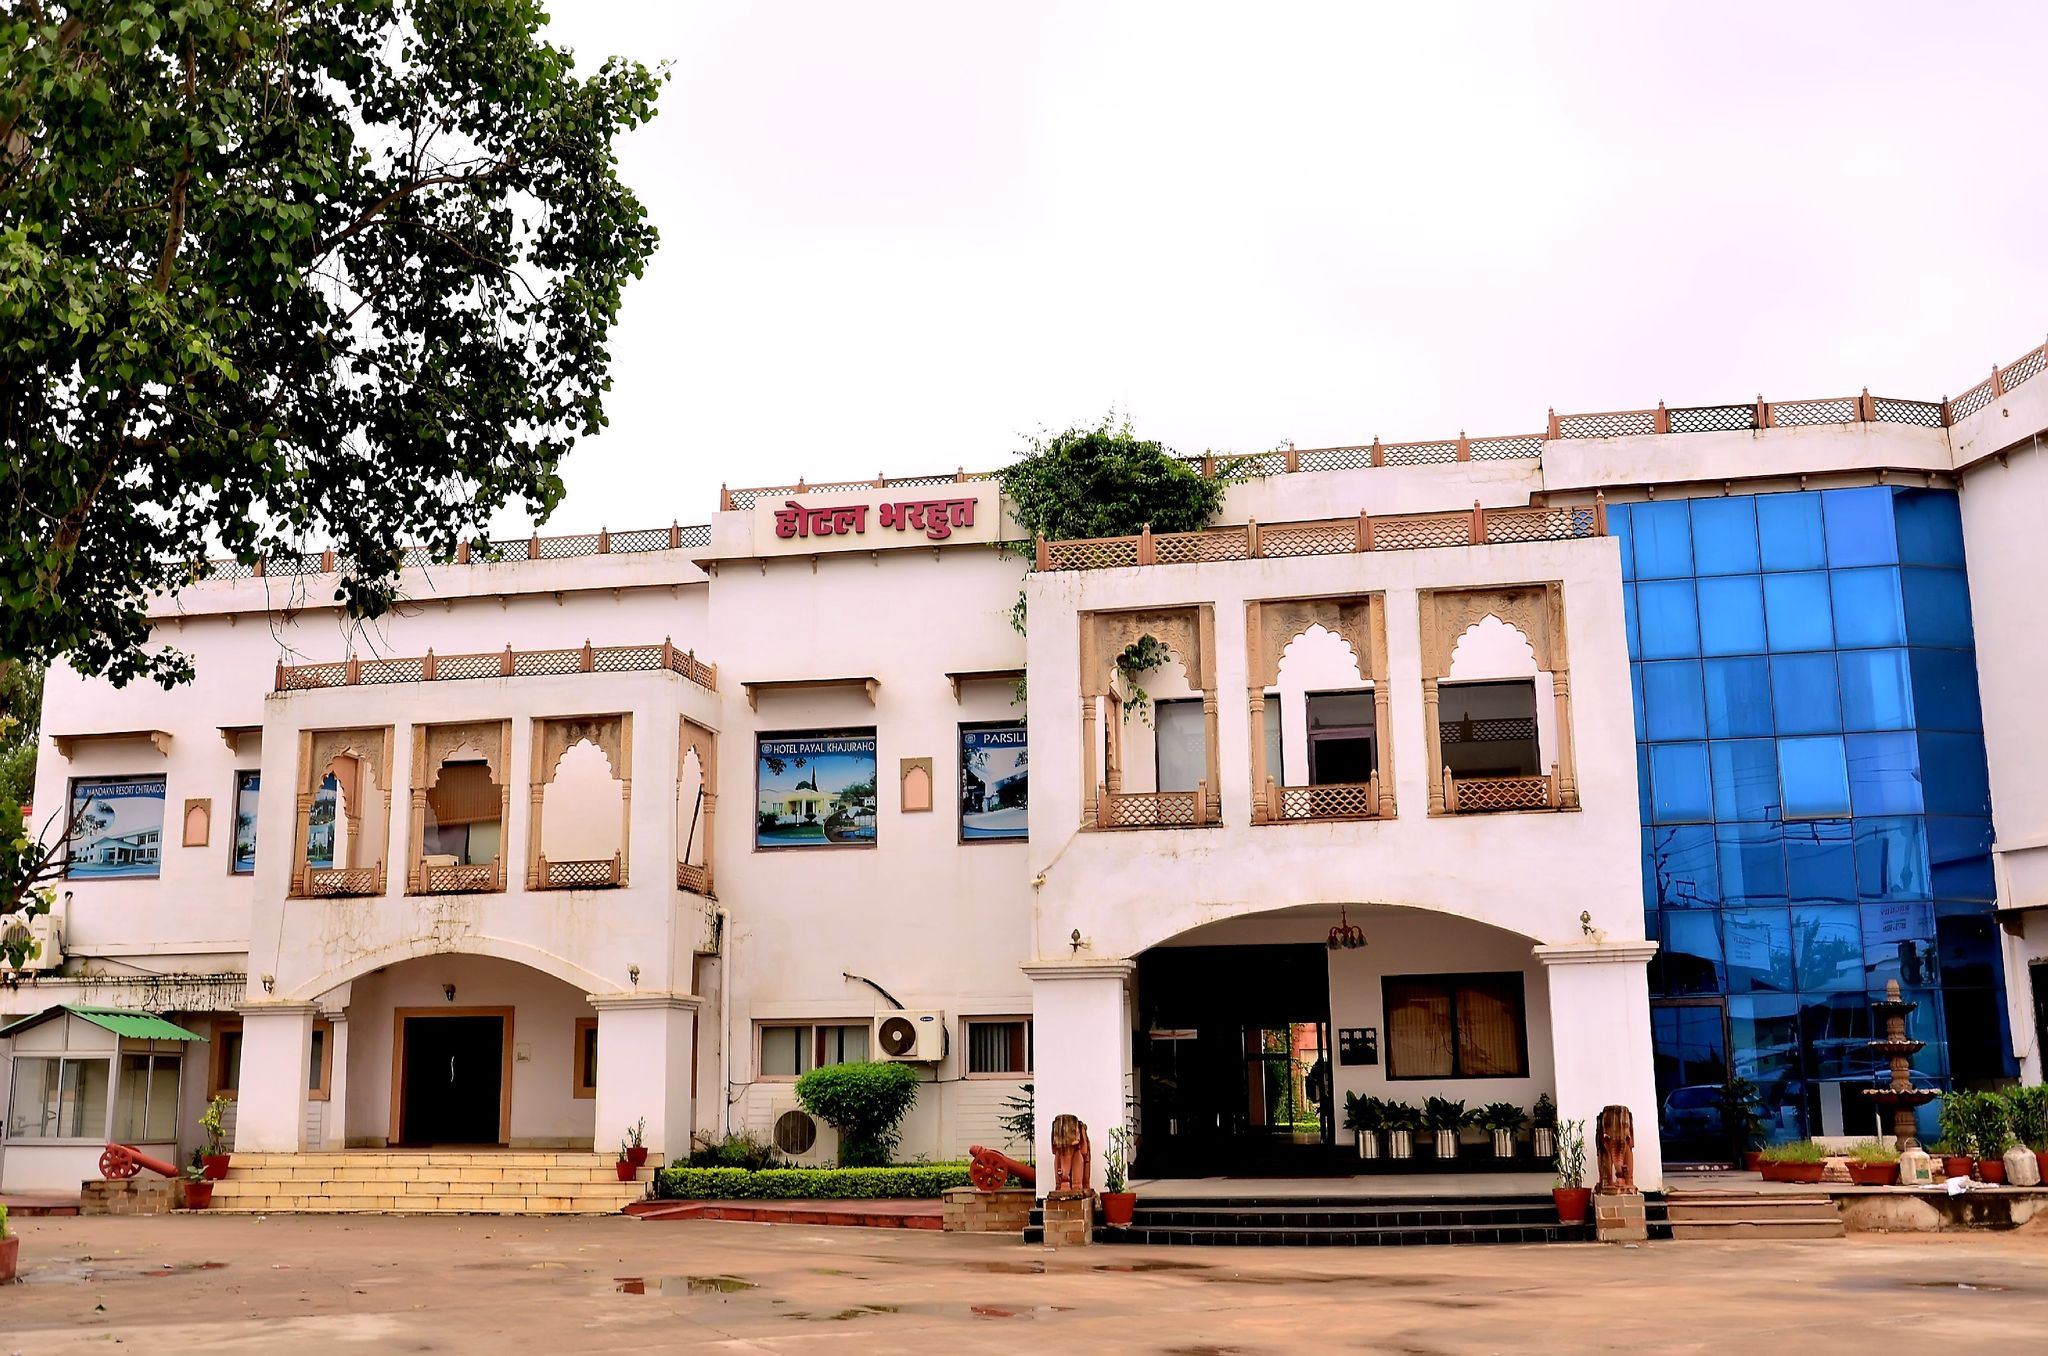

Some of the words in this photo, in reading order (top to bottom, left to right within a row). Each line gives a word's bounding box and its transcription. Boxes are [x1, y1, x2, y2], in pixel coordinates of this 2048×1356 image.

[774, 501, 869, 538] होटल
[880, 498, 978, 540] भरहुत
[983, 733, 1026, 744] PARSILI
[773, 744, 798, 754] HOTEL
[800, 743, 825, 753] PAYAL
[827, 741, 875, 753] KHAJURAHO
[116, 785, 135, 795] RESORT
